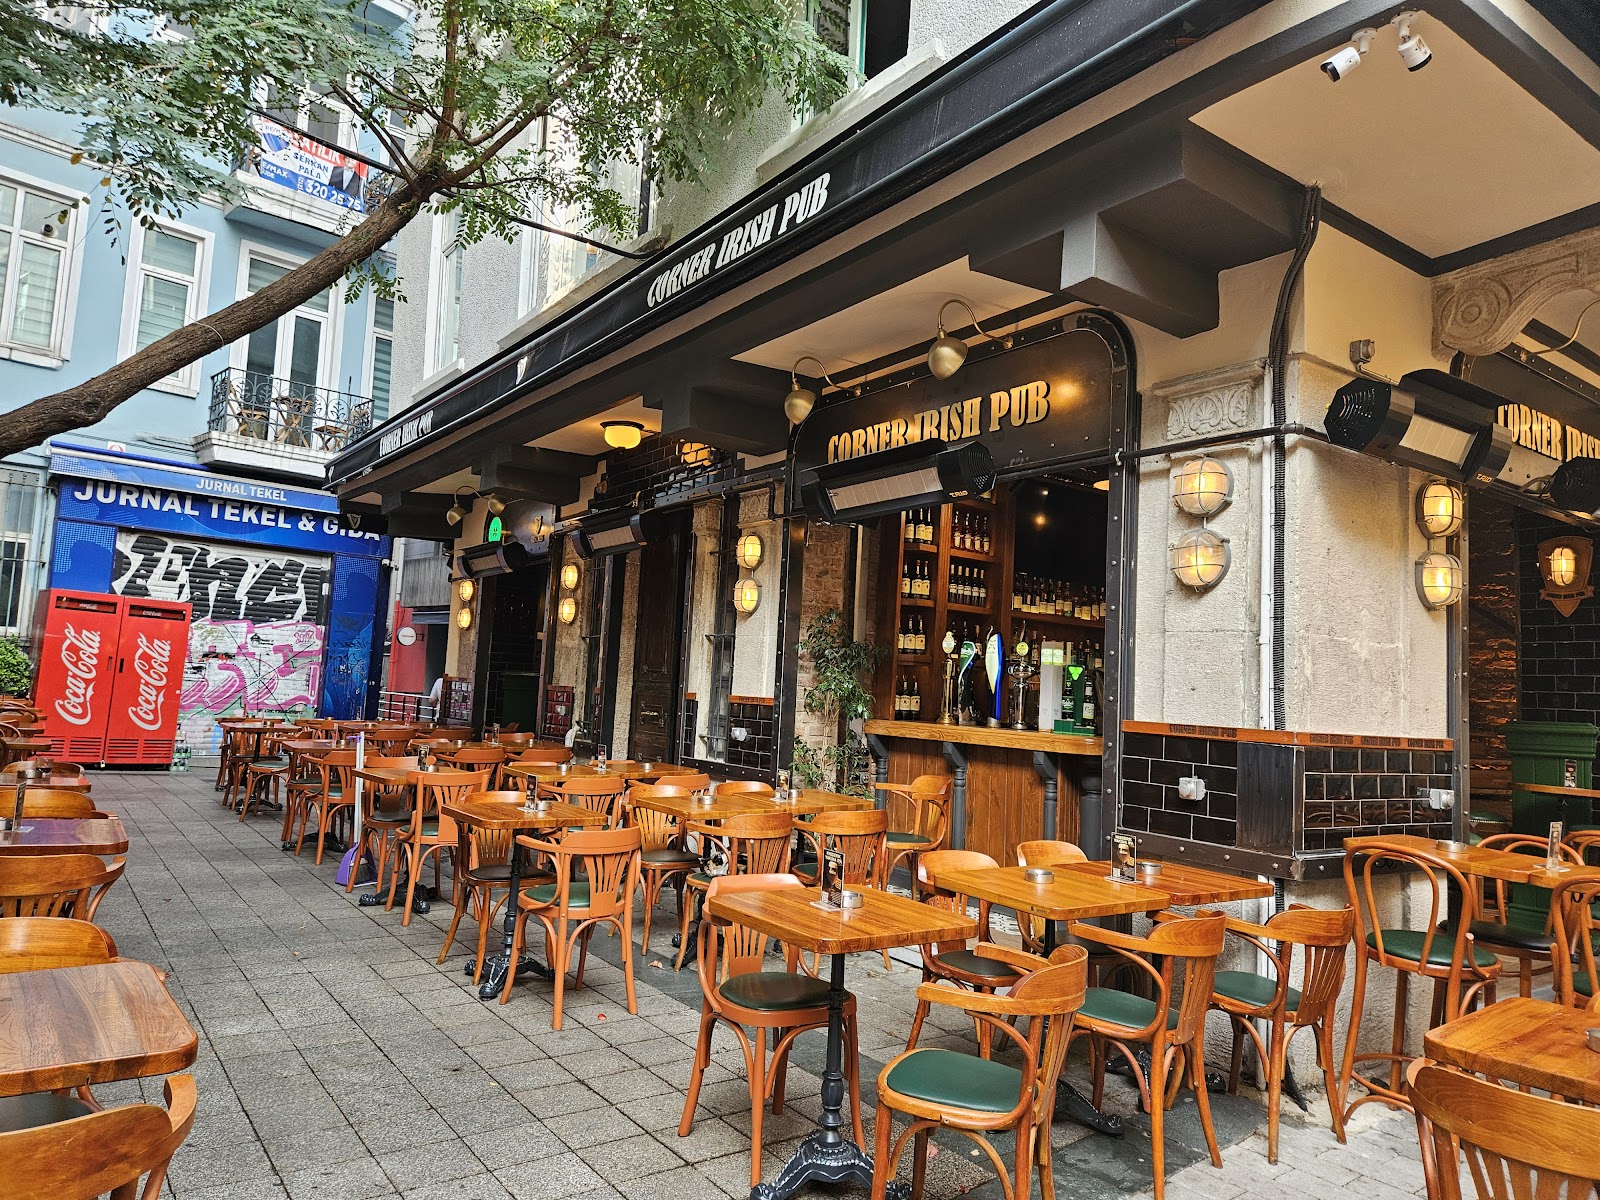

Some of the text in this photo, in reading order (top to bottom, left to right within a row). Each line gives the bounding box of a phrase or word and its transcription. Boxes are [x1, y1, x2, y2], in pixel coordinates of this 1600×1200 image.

[293, 151, 329, 173] SERKAN
[299, 164, 321, 179] PALA
[305, 179, 328, 199] 320
[329, 189, 345, 205] 25
[346, 196, 362, 211] 75
[646, 172, 831, 308] CORNER IRISH PUB
[827, 380, 1049, 465] CORNER IRISH PUB
[1497, 403, 1562, 461] CORNER
[74, 480, 200, 516] JURNAL
[208, 499, 292, 529] TEKEL
[298, 513, 316, 532] &
[196, 478, 287, 501] JURNAL TEKEL
